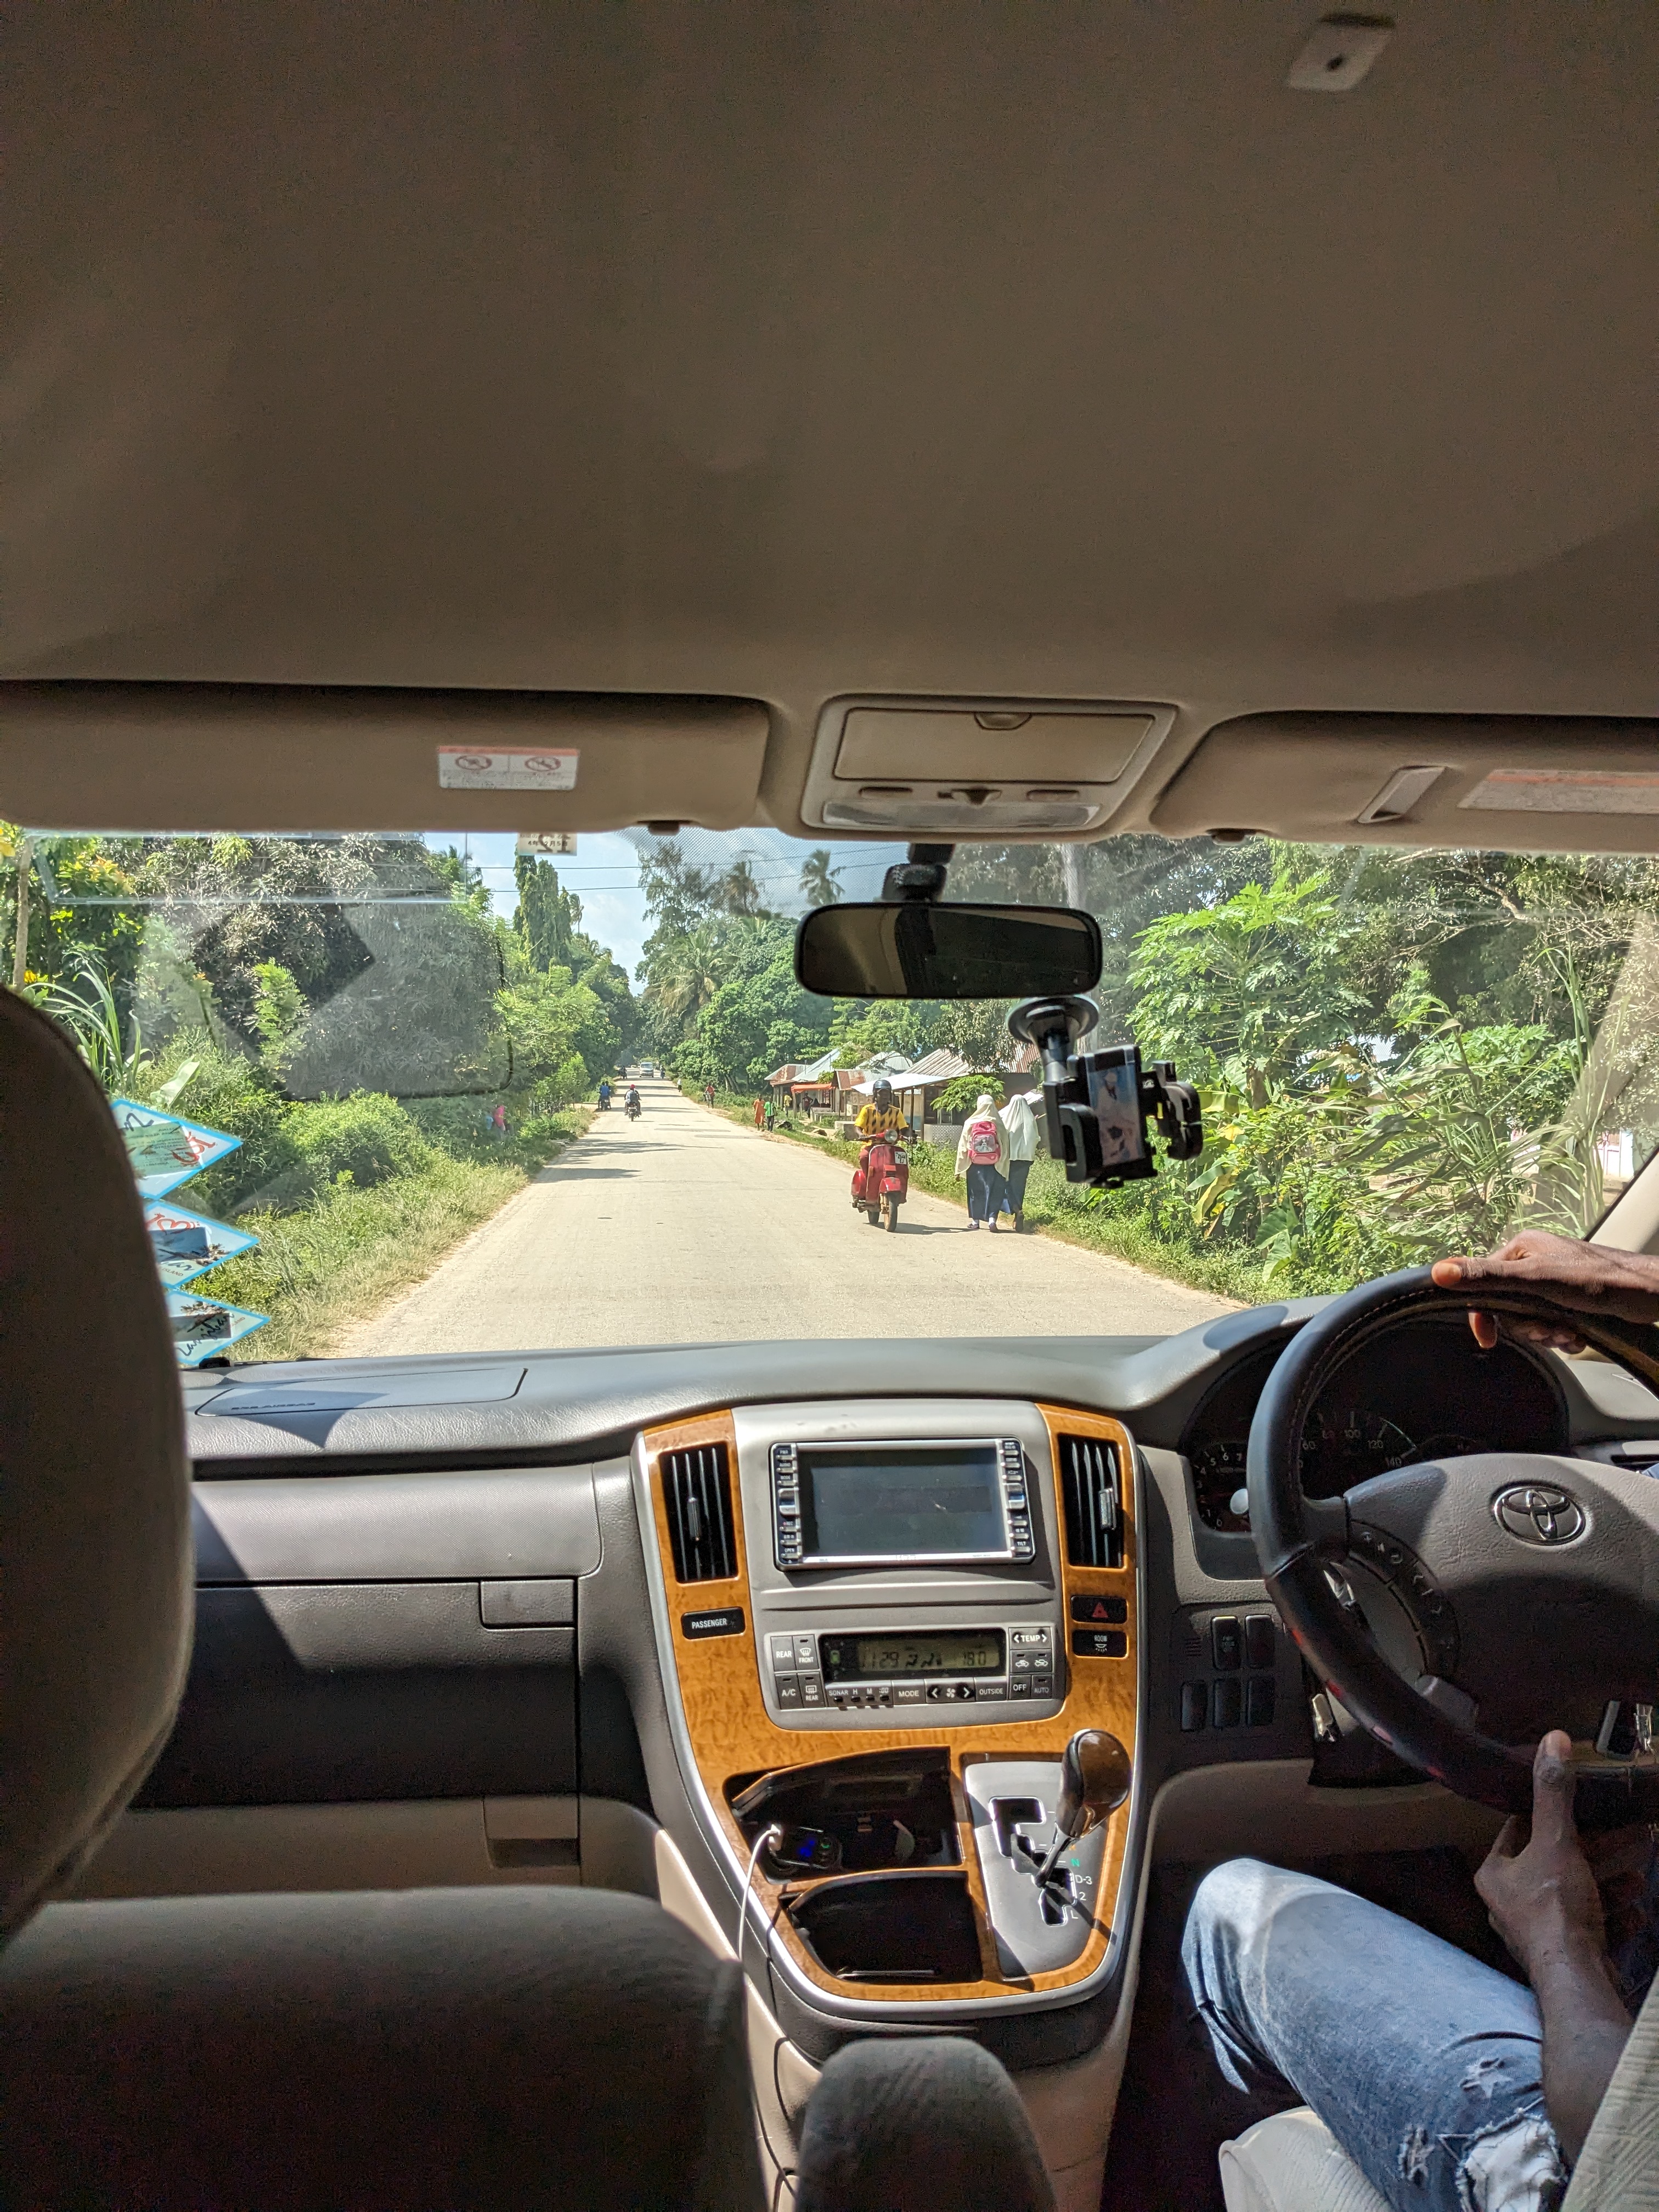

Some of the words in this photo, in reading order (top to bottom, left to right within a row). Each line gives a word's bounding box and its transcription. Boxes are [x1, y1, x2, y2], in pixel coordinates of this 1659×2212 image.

[1222, 1452, 1229, 1461] 6
[692, 1618, 727, 1629] PASSENGER
[1070, 1858, 1080, 1867] N
[1075, 1875, 1092, 1885] D-3
[1079, 1892, 1087, 1901] 2
[1070, 1910, 1079, 1919] L
